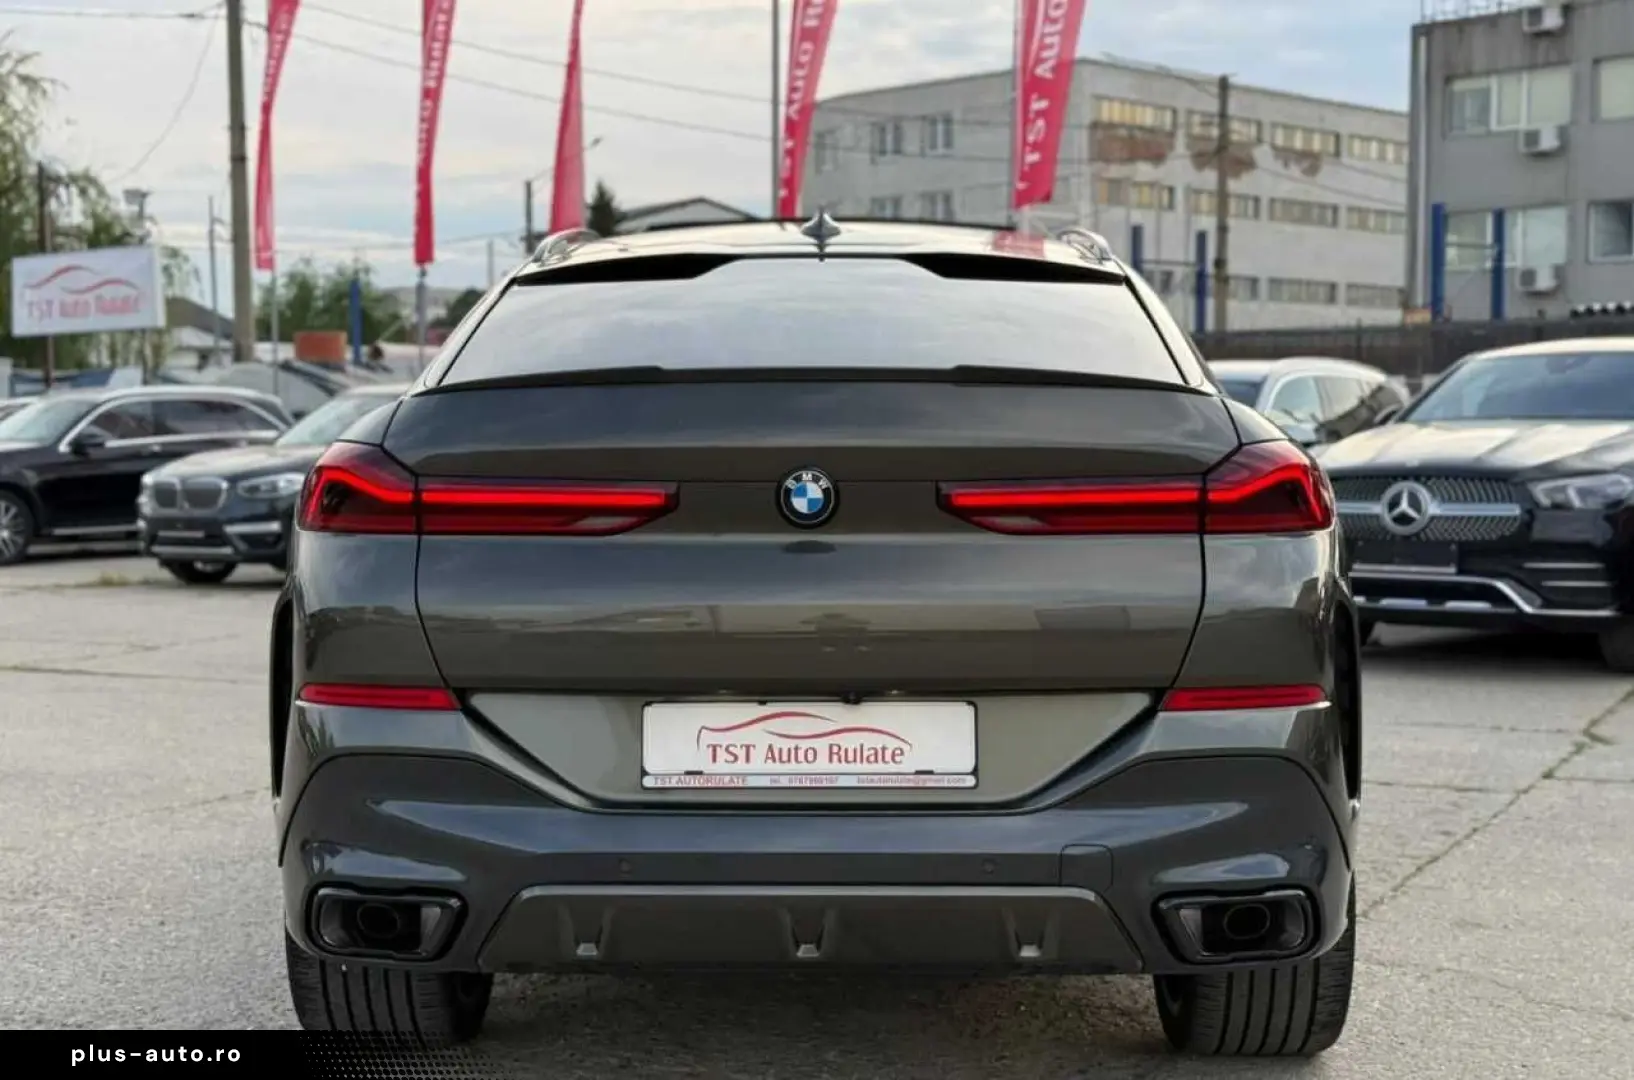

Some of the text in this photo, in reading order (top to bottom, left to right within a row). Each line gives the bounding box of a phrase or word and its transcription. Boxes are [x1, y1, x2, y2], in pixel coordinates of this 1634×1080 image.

[1024, 0, 1068, 172] TST Auto
[785, 472, 830, 489] BMW
[706, 743, 905, 765] TST Auto Rulate
[653, 776, 673, 786] TST
[676, 776, 748, 786] AUTORULATE
